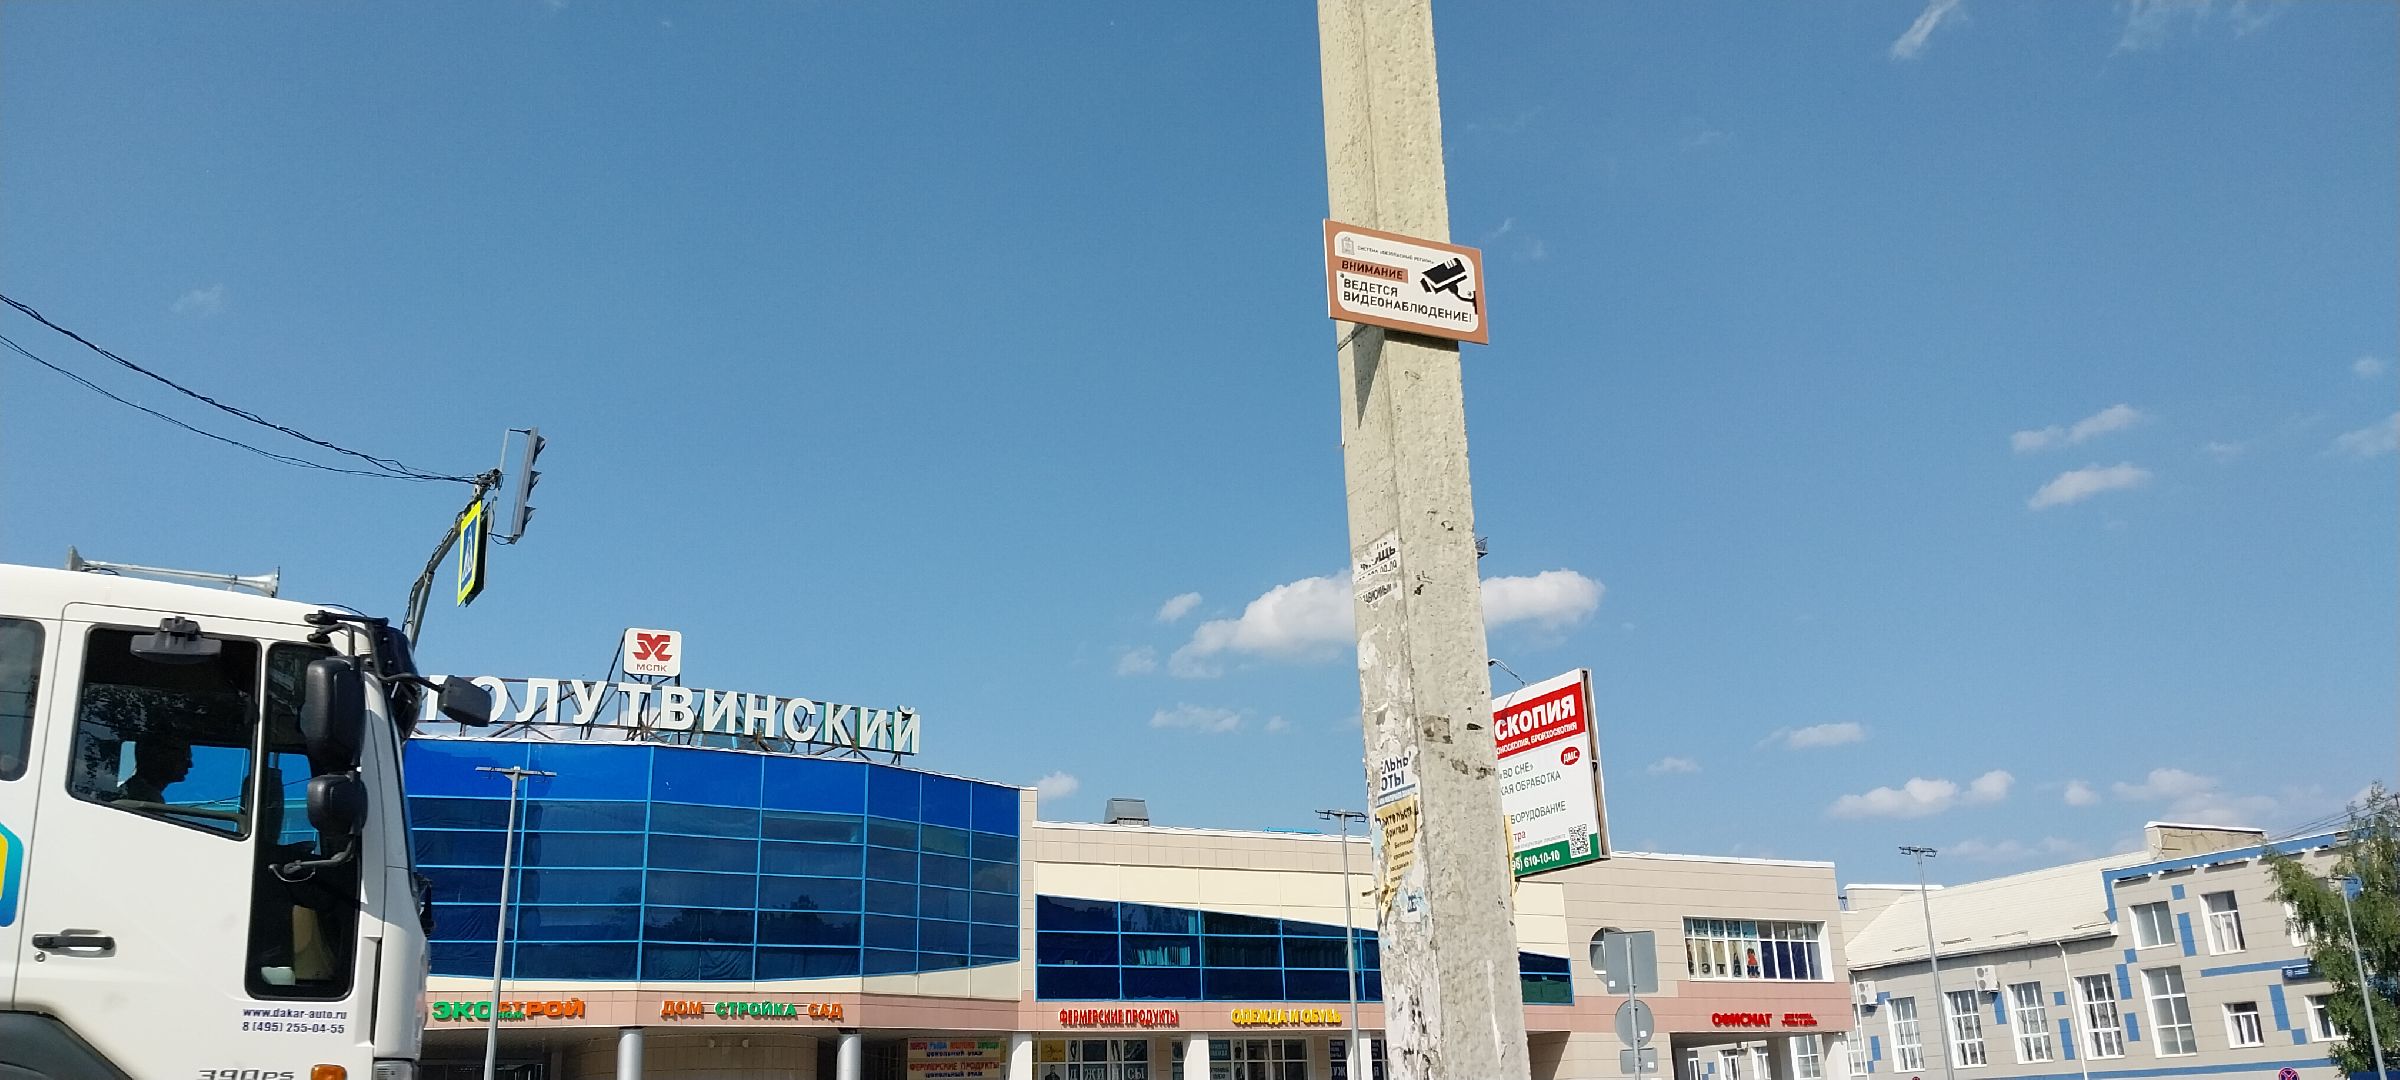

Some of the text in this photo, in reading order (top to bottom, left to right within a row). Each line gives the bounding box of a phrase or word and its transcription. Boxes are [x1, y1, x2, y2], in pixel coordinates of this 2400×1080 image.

[1341, 259, 1404, 281] ВНИМАНИЕ
[1343, 278, 1399, 298] ВЕДЕТСЯ
[1343, 291, 1473, 323] ВИДЕОНАБЛЮДЕНИЕ!
[636, 663, 668, 672] МСПК
[1494, 693, 1577, 741] СКОПИЯ
[1563, 750, 1579, 764] ДМС
[1515, 770, 1562, 792] ОБРАБОТКА
[1510, 800, 1567, 825] БОРУДОВАНИЕ
[1523, 849, 1560, 868] 610-10-10
[242, 1008, 347, 1020] www.dakar-auto.ru
[661, 1000, 843, 1019] ДОМ СТРОЙКА САД
[1059, 1009, 1180, 1027] ФЕРМЕРСКИЕ ПРОДУКТЫ
[1231, 1008, 1342, 1026] ОДЕЖДА И ОБУВЬ
[242, 1021, 249, 1031] 8
[286, 1023, 345, 1034] 255-04-55
